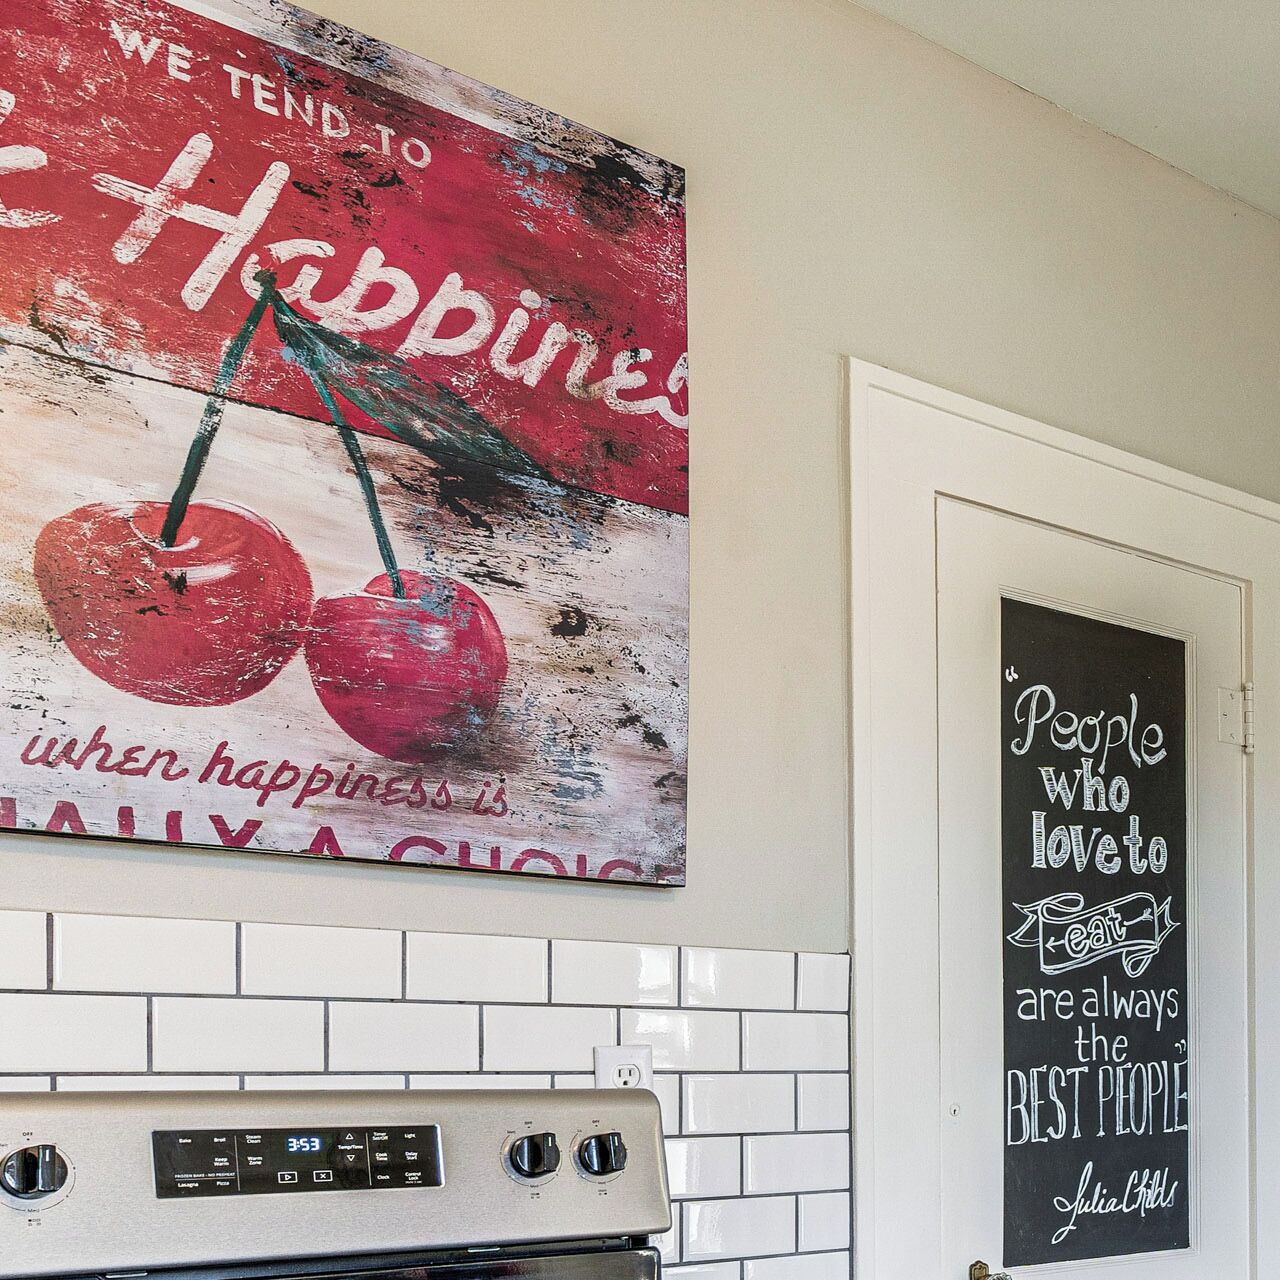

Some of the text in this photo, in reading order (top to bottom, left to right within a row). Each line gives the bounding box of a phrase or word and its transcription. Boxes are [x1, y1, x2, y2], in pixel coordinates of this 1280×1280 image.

[108, 21, 433, 169] WE TEND TO
[20, 725, 510, 819] when happiness is
[1038, 757, 1131, 813] who
[1064, 907, 1127, 958] eat
[1016, 976, 1179, 1031] are always
[1074, 1022, 1128, 1062] the
[1007, 1064, 1089, 1146] BEST
[287, 1137, 320, 1151] 3:53
[1051, 1160, 1122, 1244] Julia
